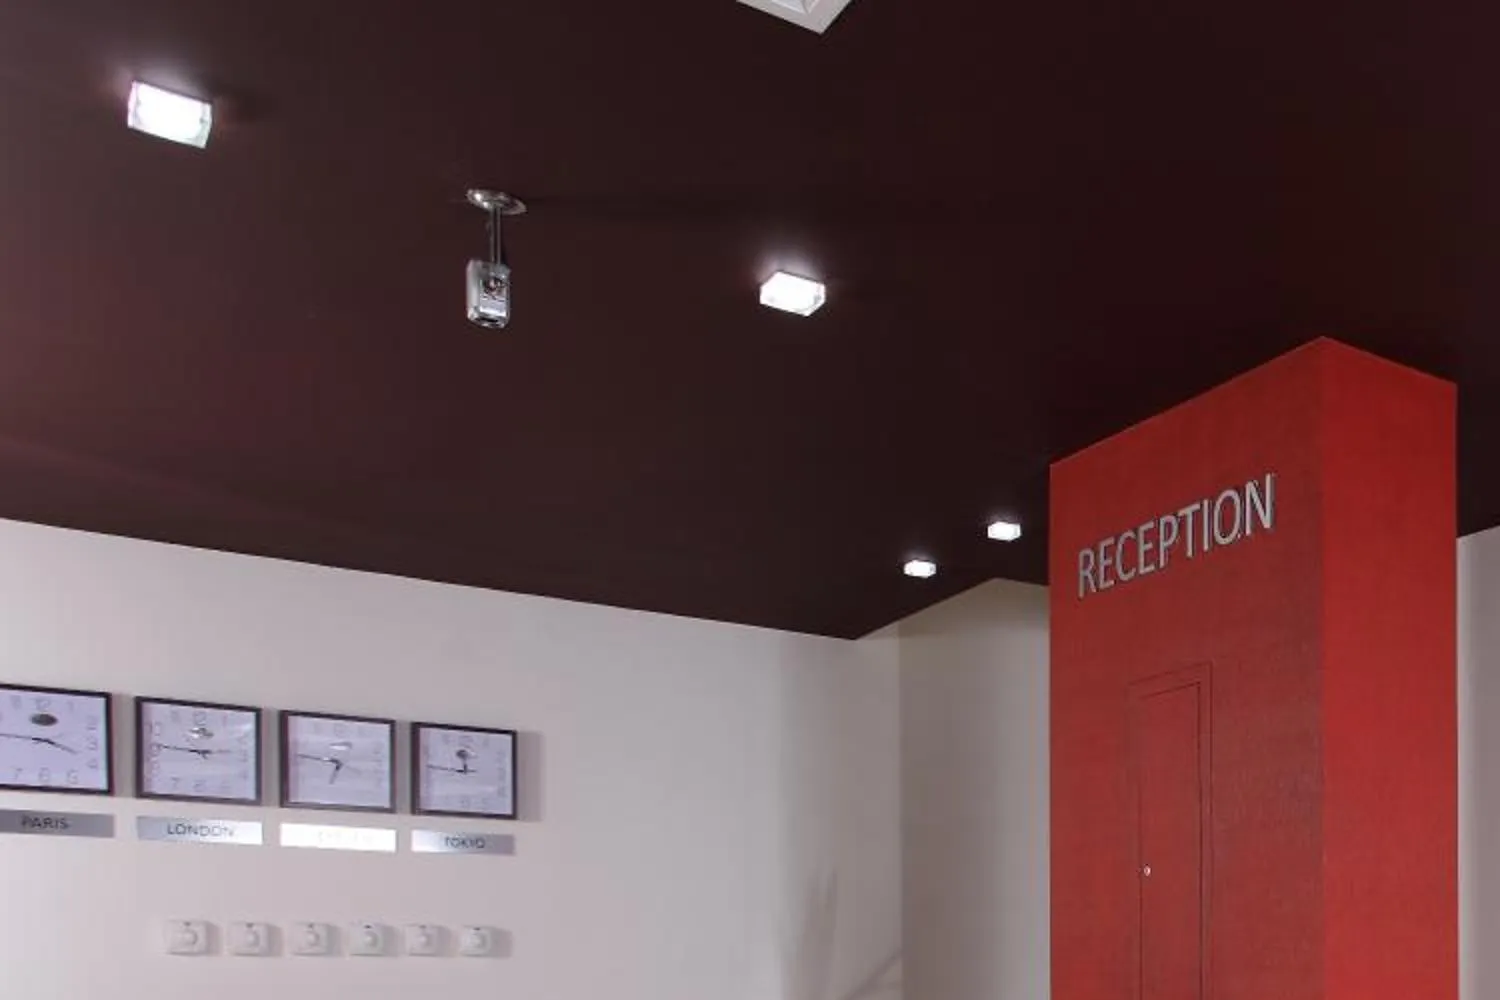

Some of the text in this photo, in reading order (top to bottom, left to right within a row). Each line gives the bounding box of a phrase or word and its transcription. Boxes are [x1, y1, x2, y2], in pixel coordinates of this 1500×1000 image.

[1077, 473, 1275, 599] RECEPTION
[21, 815, 70, 830] PARIS
[167, 823, 235, 837] LONDON
[444, 836, 486, 849] TOKYO
